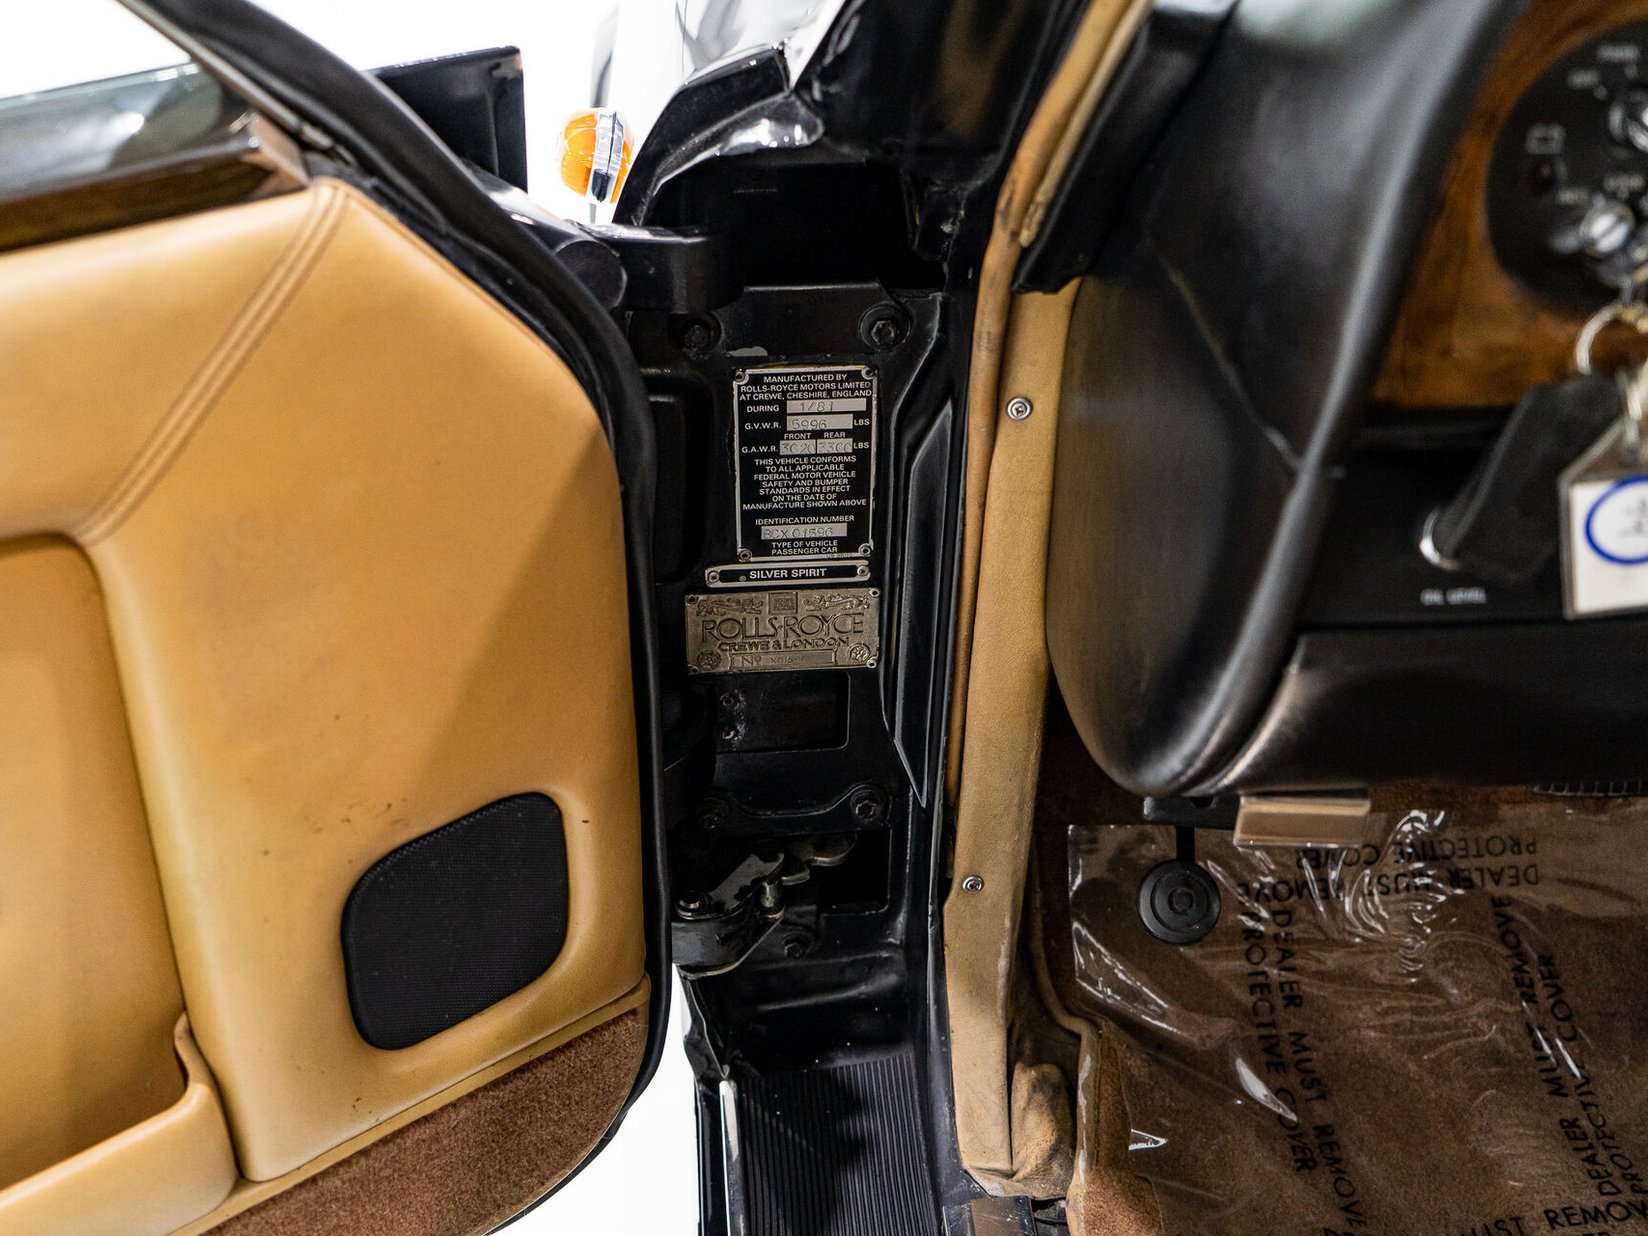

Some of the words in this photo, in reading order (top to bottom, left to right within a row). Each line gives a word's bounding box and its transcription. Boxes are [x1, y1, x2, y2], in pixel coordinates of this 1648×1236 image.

[764, 374, 834, 383] MANUFACTURED
[741, 384, 798, 392] ROLLS-ROYCE
[800, 382, 836, 390] MOTORS
[838, 382, 871, 390] LIMITED
[752, 392, 784, 401] CREWE,
[787, 391, 830, 399] CHESHIRE,
[832, 390, 872, 398] ENGLAND
[746, 404, 780, 412] DURING
[800, 402, 834, 412] 1/81
[745, 422, 782, 430] G.V.W.R.
[792, 419, 827, 430] 5996
[776, 456, 808, 464] VEHICLE
[810, 456, 856, 464] CONFORMS
[795, 464, 844, 472] APPLICABLE
[759, 487, 810, 495] STANDARDS
[742, 502, 805, 510] MANUFACTURE
[756, 516, 818, 525] IDENTIFICATION
[772, 548, 820, 556] PASSENGER
[750, 570, 788, 580] SILVER
[791, 568, 827, 578] SPIRIT
[718, 640, 770, 651] CREWE
[772, 640, 782, 650] &
[784, 637, 850, 650] LONDON
[1393, 836, 1537, 864] PROTECTIVE
[1449, 864, 1539, 889] DEALER
[1490, 896, 1538, 1004] REMOVE
[1241, 911, 1287, 1074] PROTECTIVE
[1538, 954, 1577, 1041] COVER
[1271, 909, 1303, 1009] DEALER
[1288, 1030, 1327, 1102] MUST
[1312, 1124, 1367, 1226] REMOVE
[1560, 1117, 1621, 1195] DEALER
